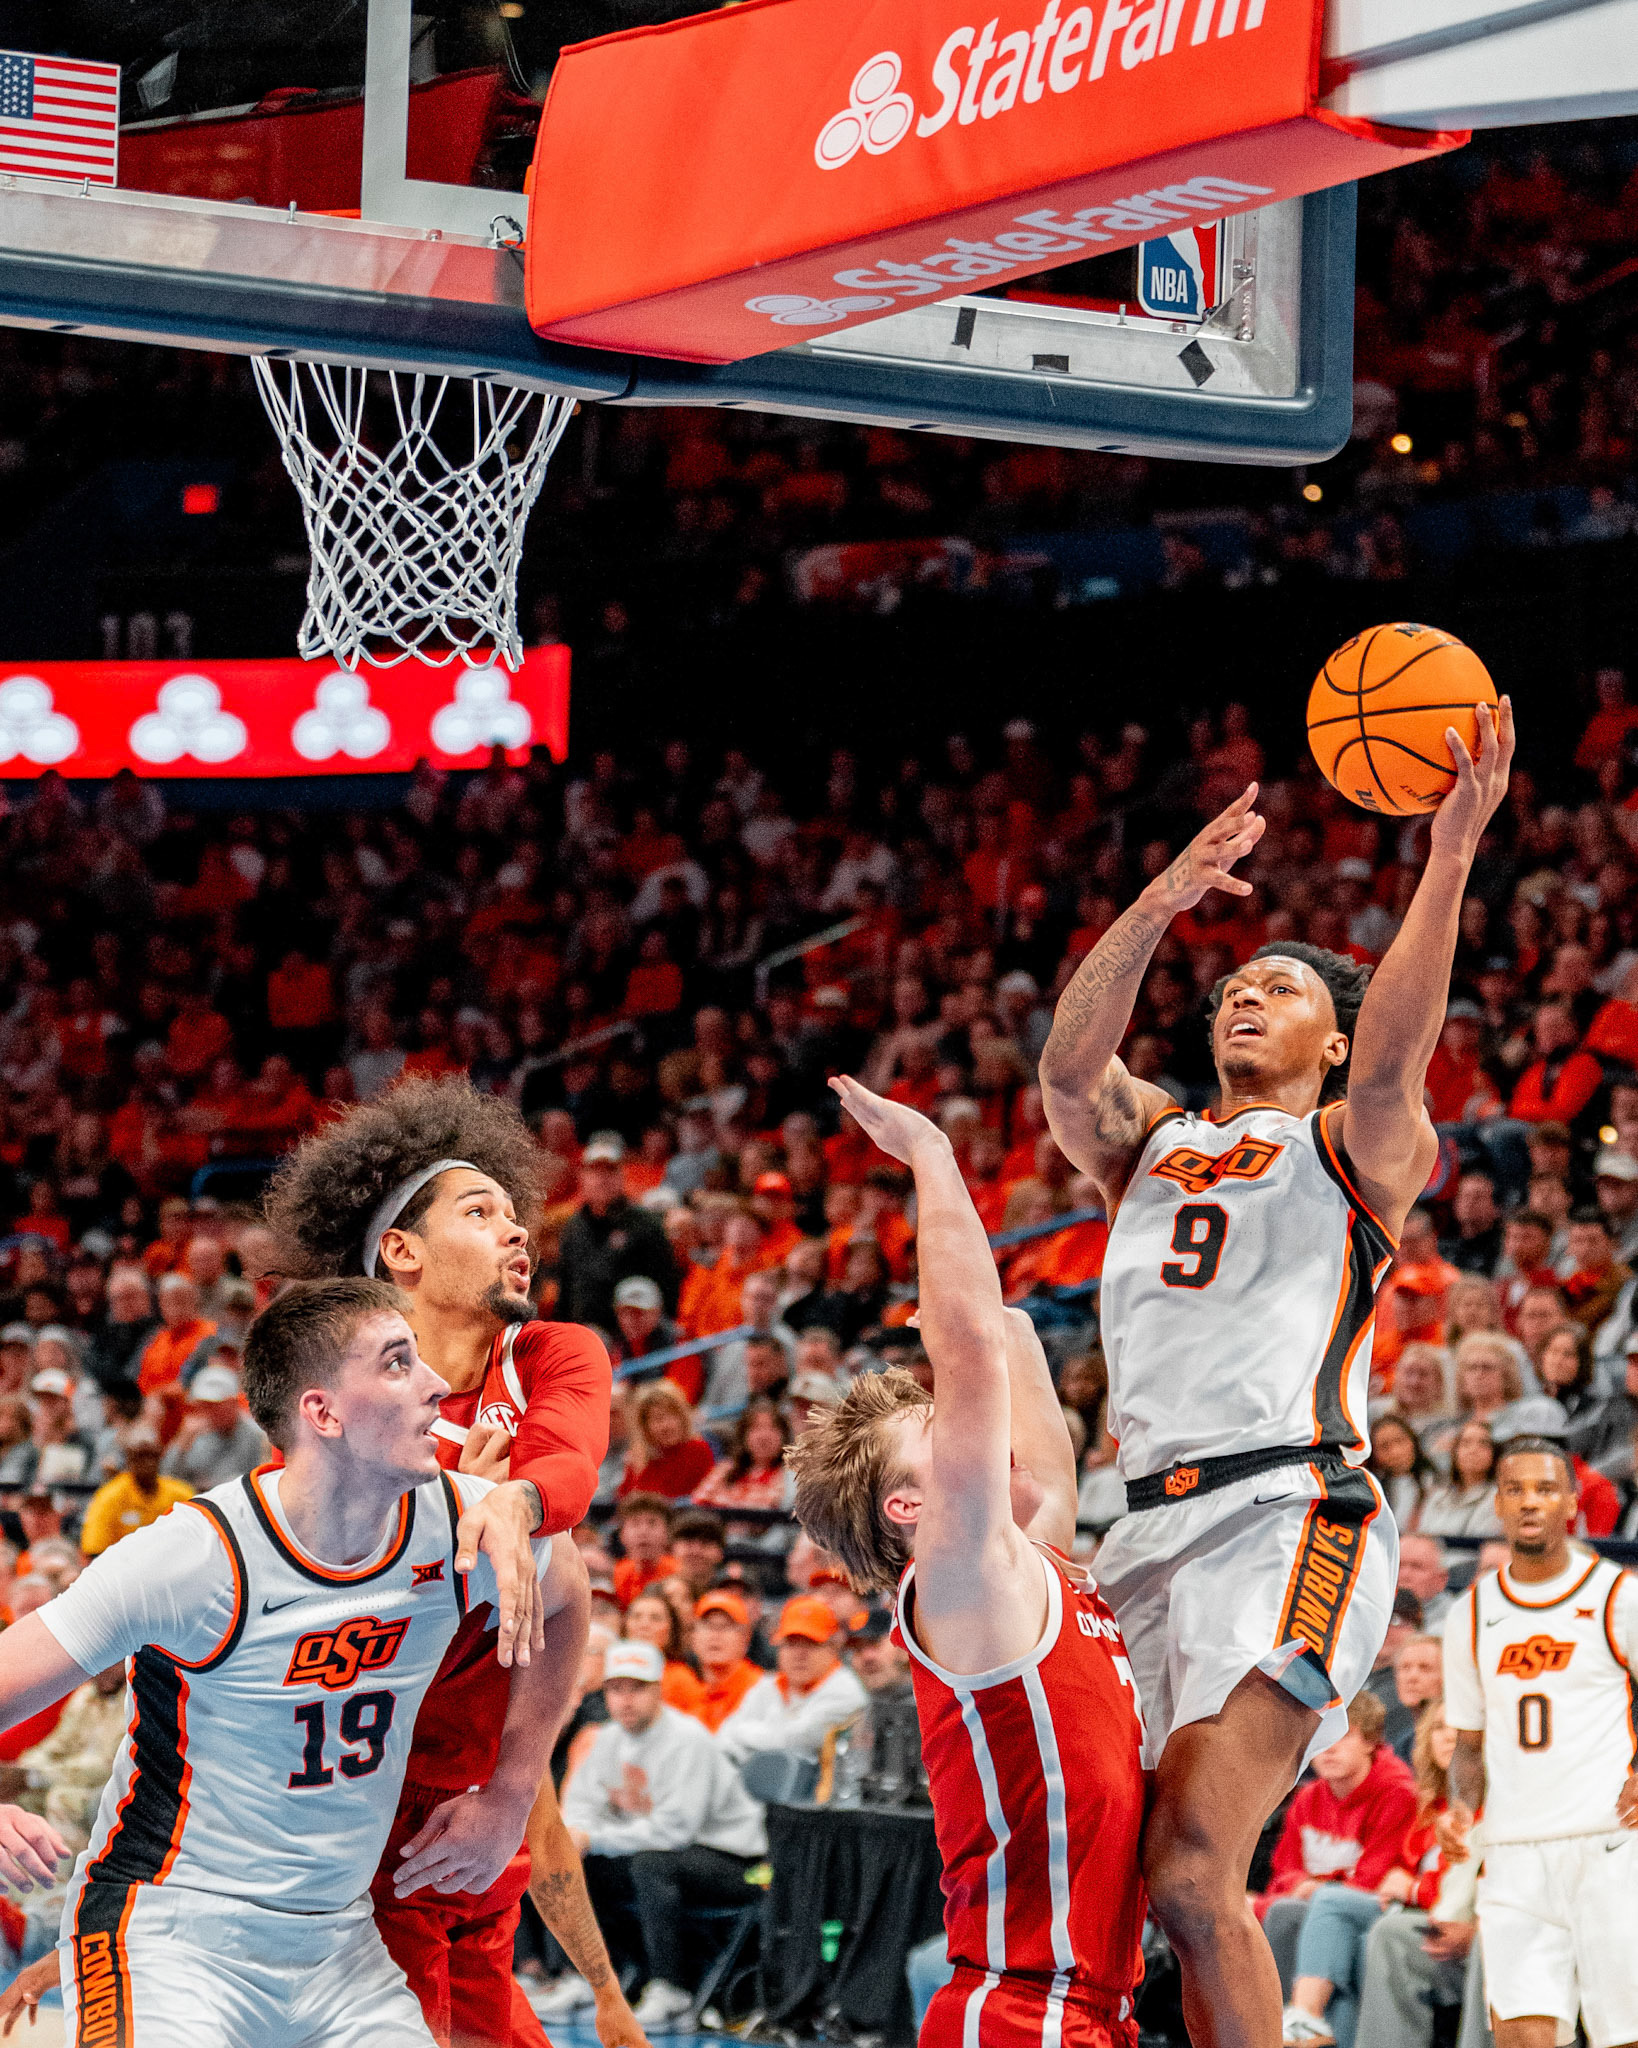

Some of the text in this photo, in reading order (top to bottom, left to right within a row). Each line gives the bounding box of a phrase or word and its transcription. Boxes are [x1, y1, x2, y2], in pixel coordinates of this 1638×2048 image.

[1150, 265, 1188, 304] NBA
[1160, 1203, 1229, 1290] 9
[1165, 1467, 1199, 1496] OSU
[411, 1559, 445, 1587] XII
[1288, 1515, 1354, 1655] OWBOYS
[283, 1615, 412, 1692] OSU
[1496, 1634, 1577, 1680] OSU
[288, 1689, 397, 1789] 19
[1518, 1693, 1552, 1753] 0
